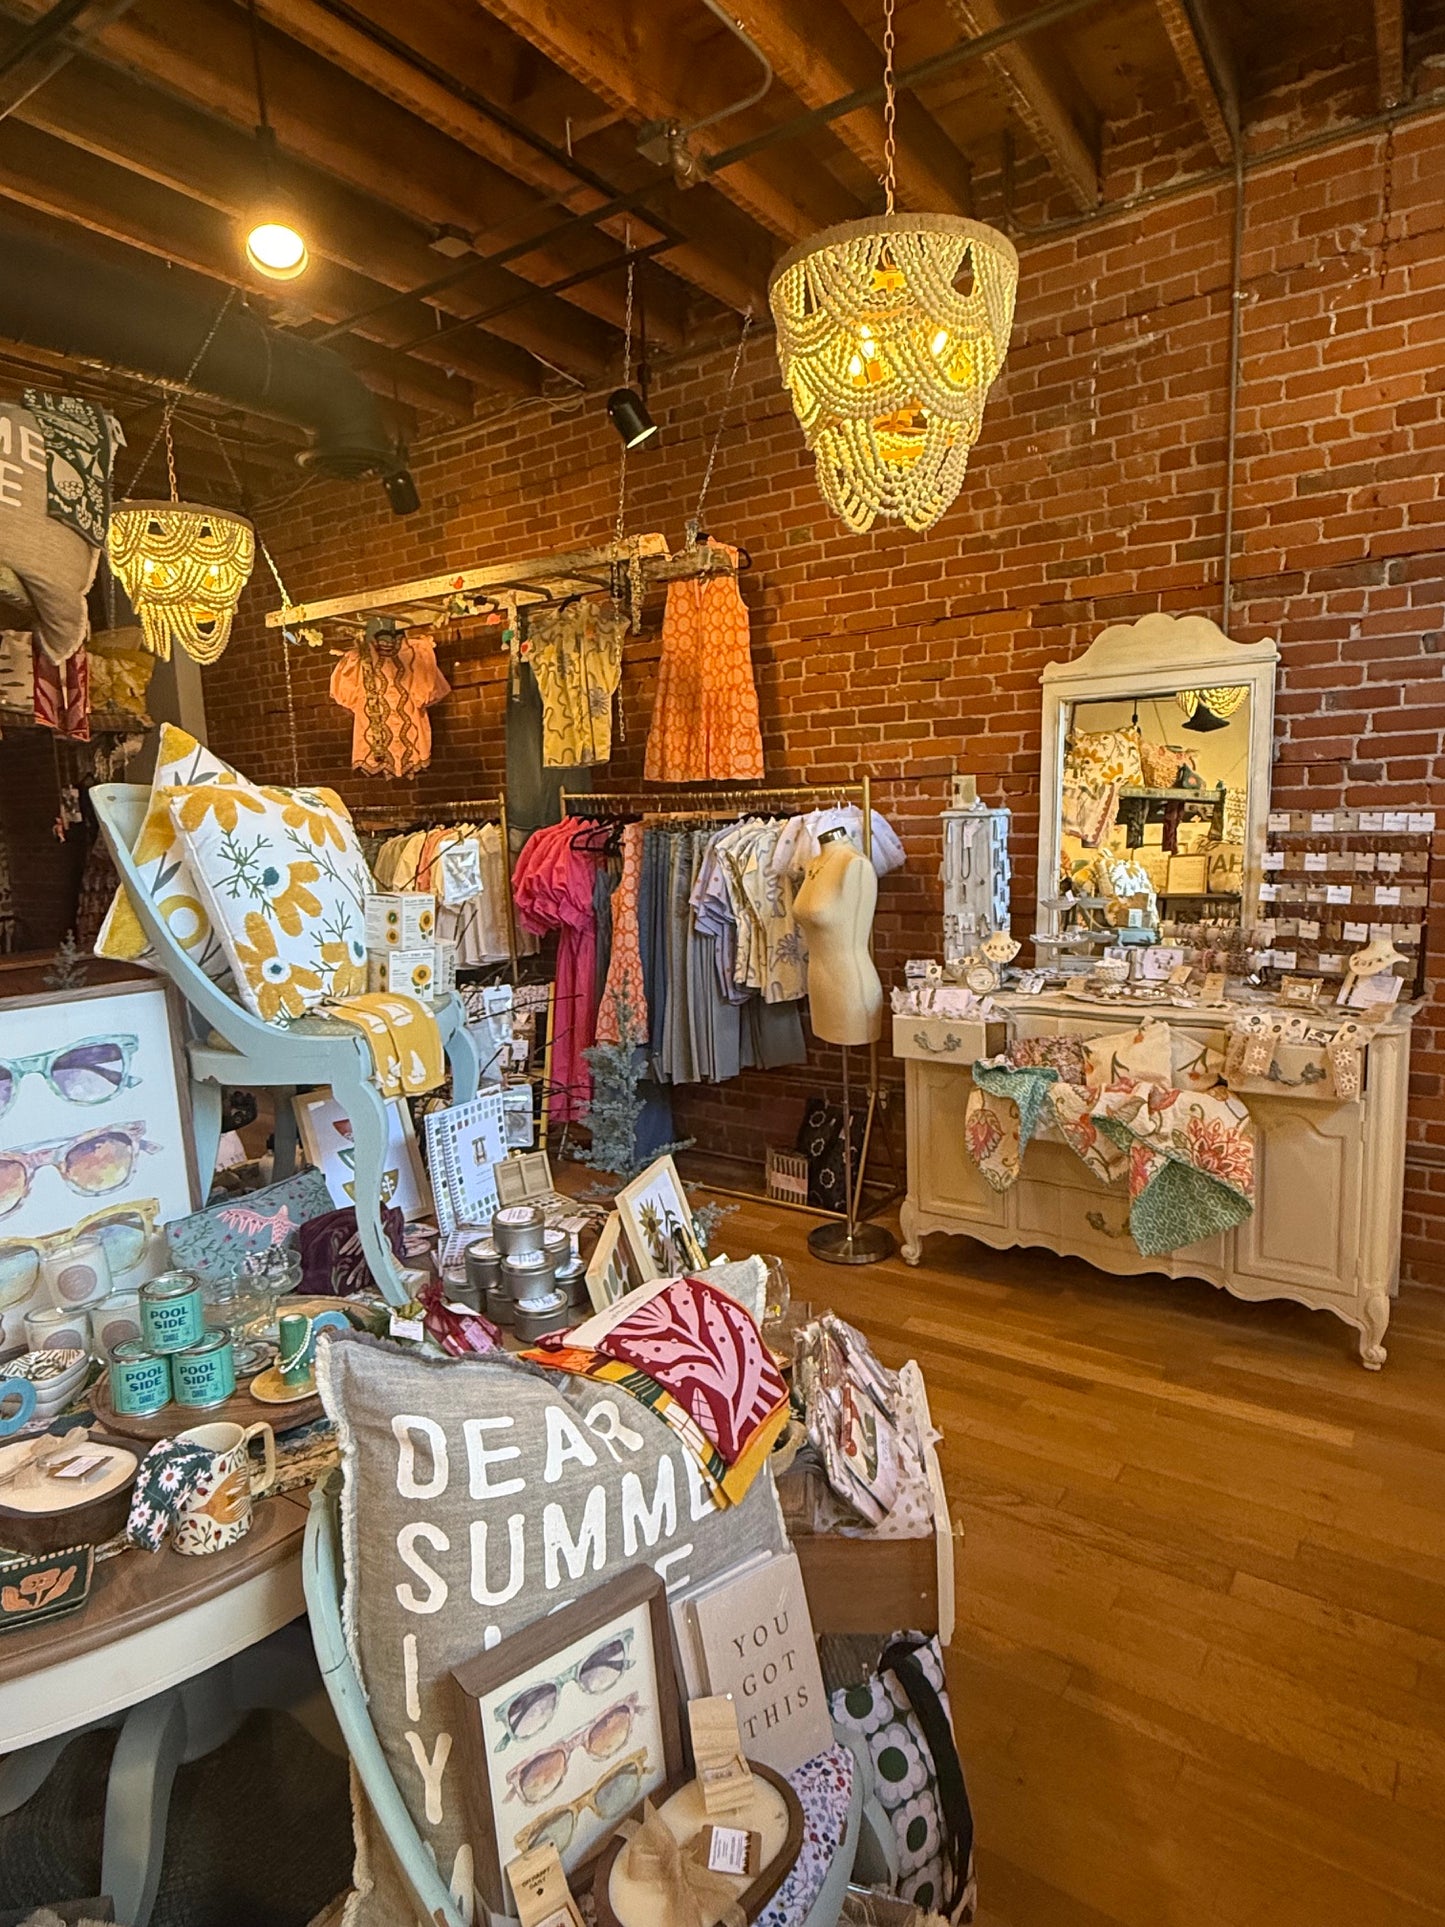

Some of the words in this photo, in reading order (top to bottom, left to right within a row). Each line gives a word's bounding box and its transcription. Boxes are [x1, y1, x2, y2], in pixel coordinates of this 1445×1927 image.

[150, 1306, 188, 1319] POOL
[154, 1316, 187, 1330] SIDE
[125, 1366, 164, 1382] POOL
[180, 1362, 216, 1375] POOL
[129, 1376, 162, 1392] SIDE
[183, 1372, 215, 1386] SIDE
[391, 1399, 644, 1499] DEAR
[396, 1443, 735, 1614] SUMME
[731, 1611, 790, 1659] YOU
[741, 1649, 796, 1697] GOT
[743, 1685, 809, 1740] THIS
